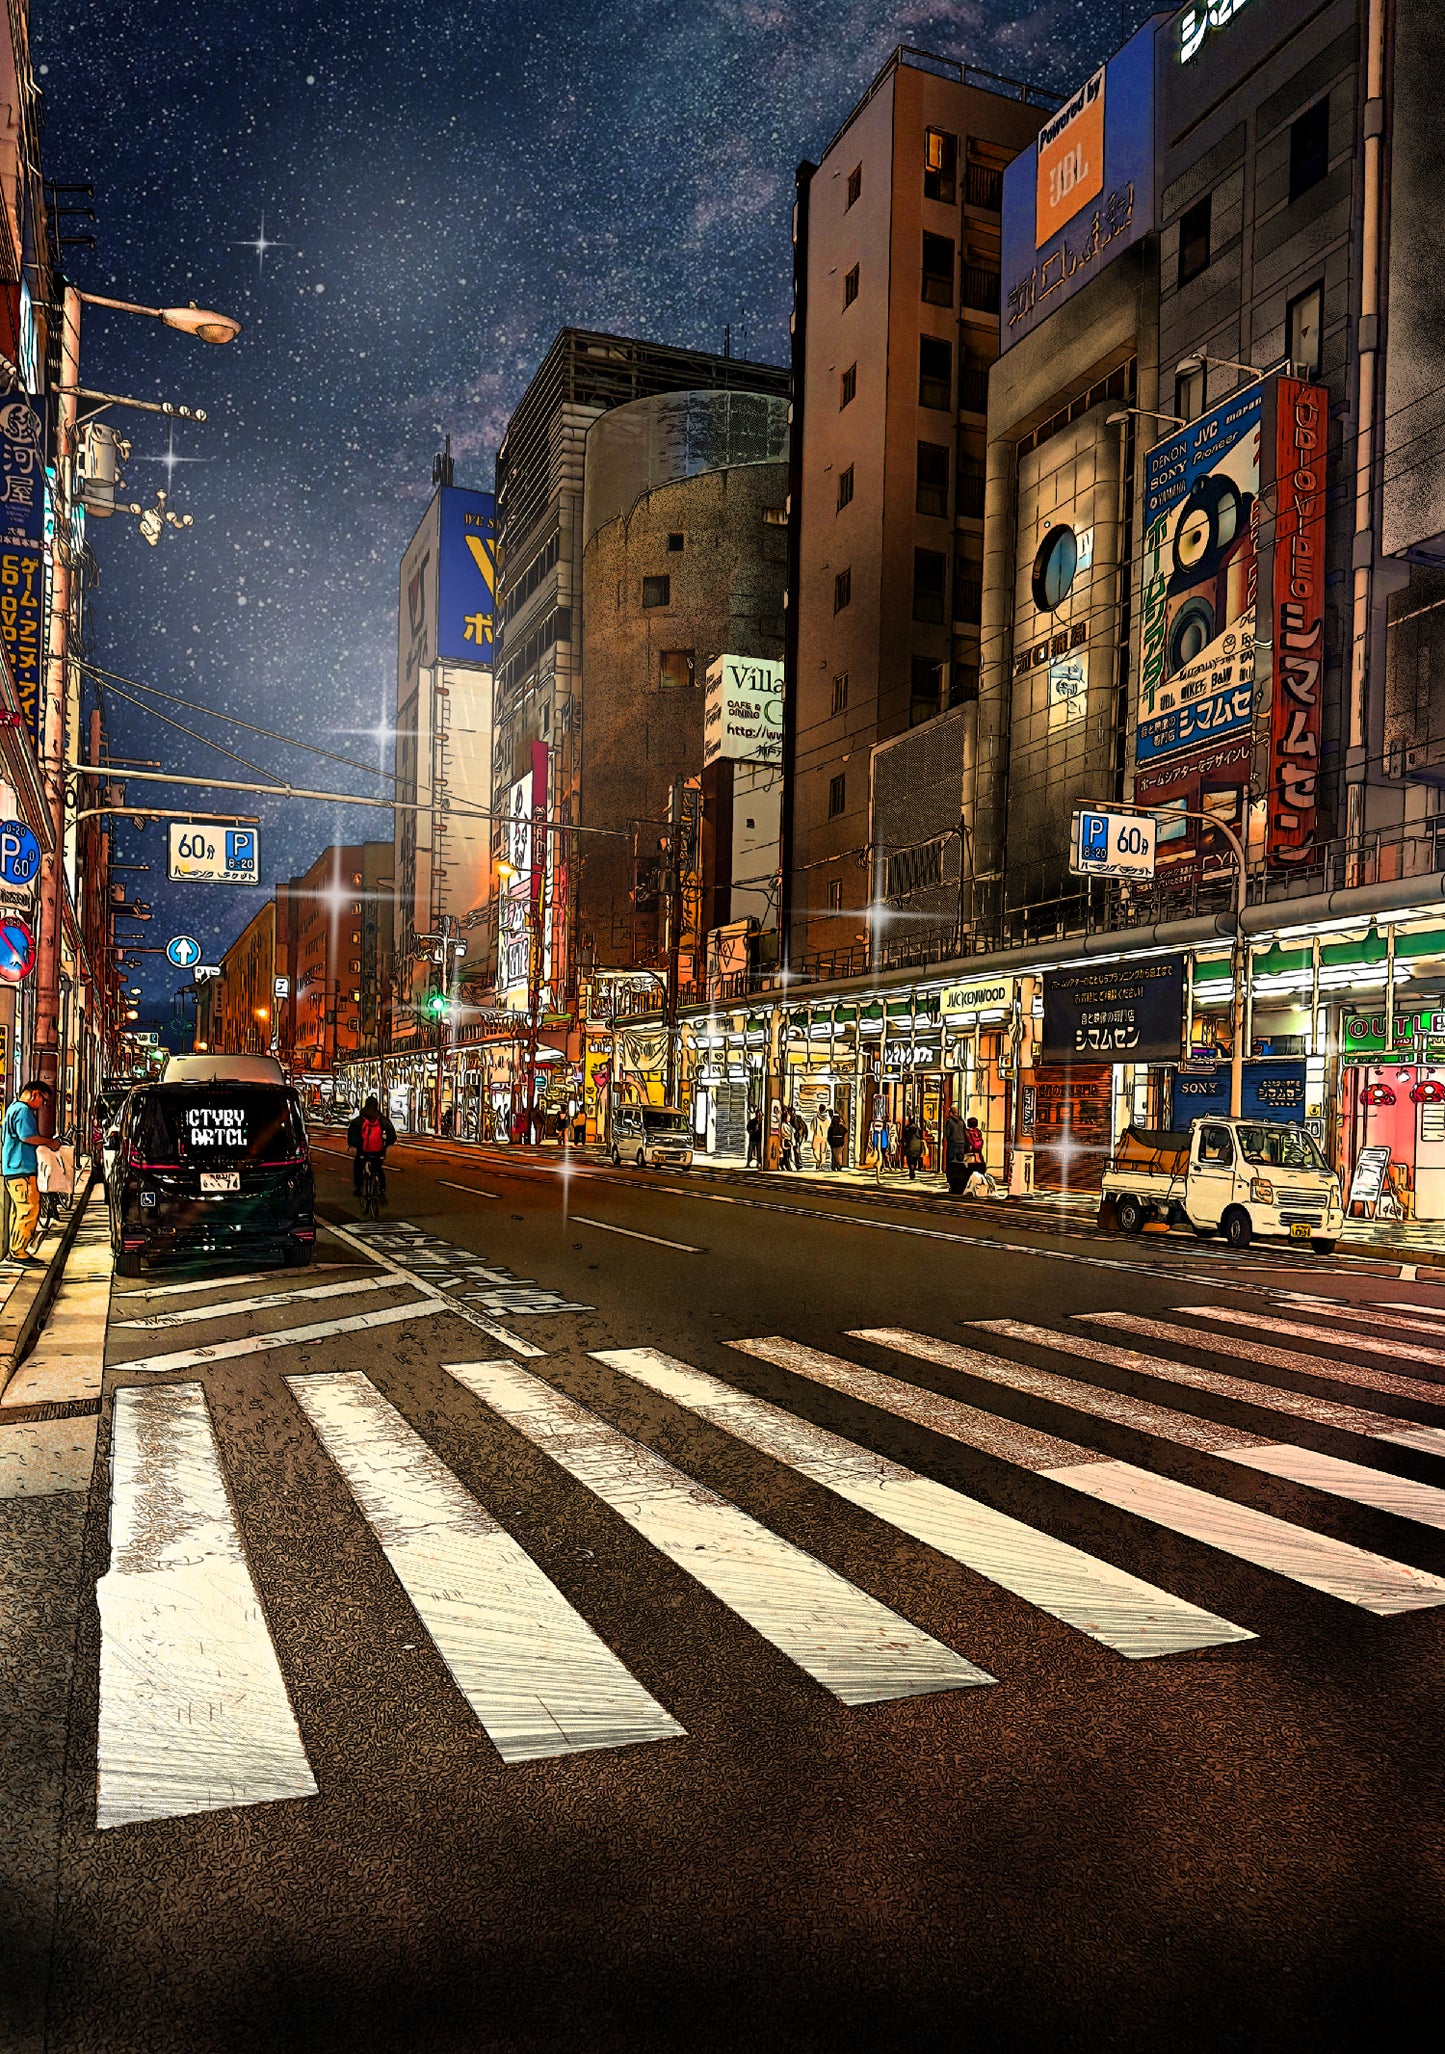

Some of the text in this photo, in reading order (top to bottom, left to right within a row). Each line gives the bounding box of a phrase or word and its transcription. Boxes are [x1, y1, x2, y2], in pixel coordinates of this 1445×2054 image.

[1039, 73, 1102, 154] Powered by
[1050, 143, 1088, 207] JBL
[1152, 441, 1187, 473] DENON
[1194, 421, 1218, 447] JVC
[1150, 431, 1239, 491] SONY Pioneer
[727, 700, 752, 710] CAFE
[729, 708, 760, 720] DINING
[1274, 603, 1321, 862] シマムセン
[1090, 820, 1103, 844] P
[1, 832, 21, 873] P
[234, 833, 249, 857] P
[1084, 847, 1107, 858] 8-20
[228, 859, 254, 869] 8-20
[1075, 1026, 1140, 1051] シマムセン
